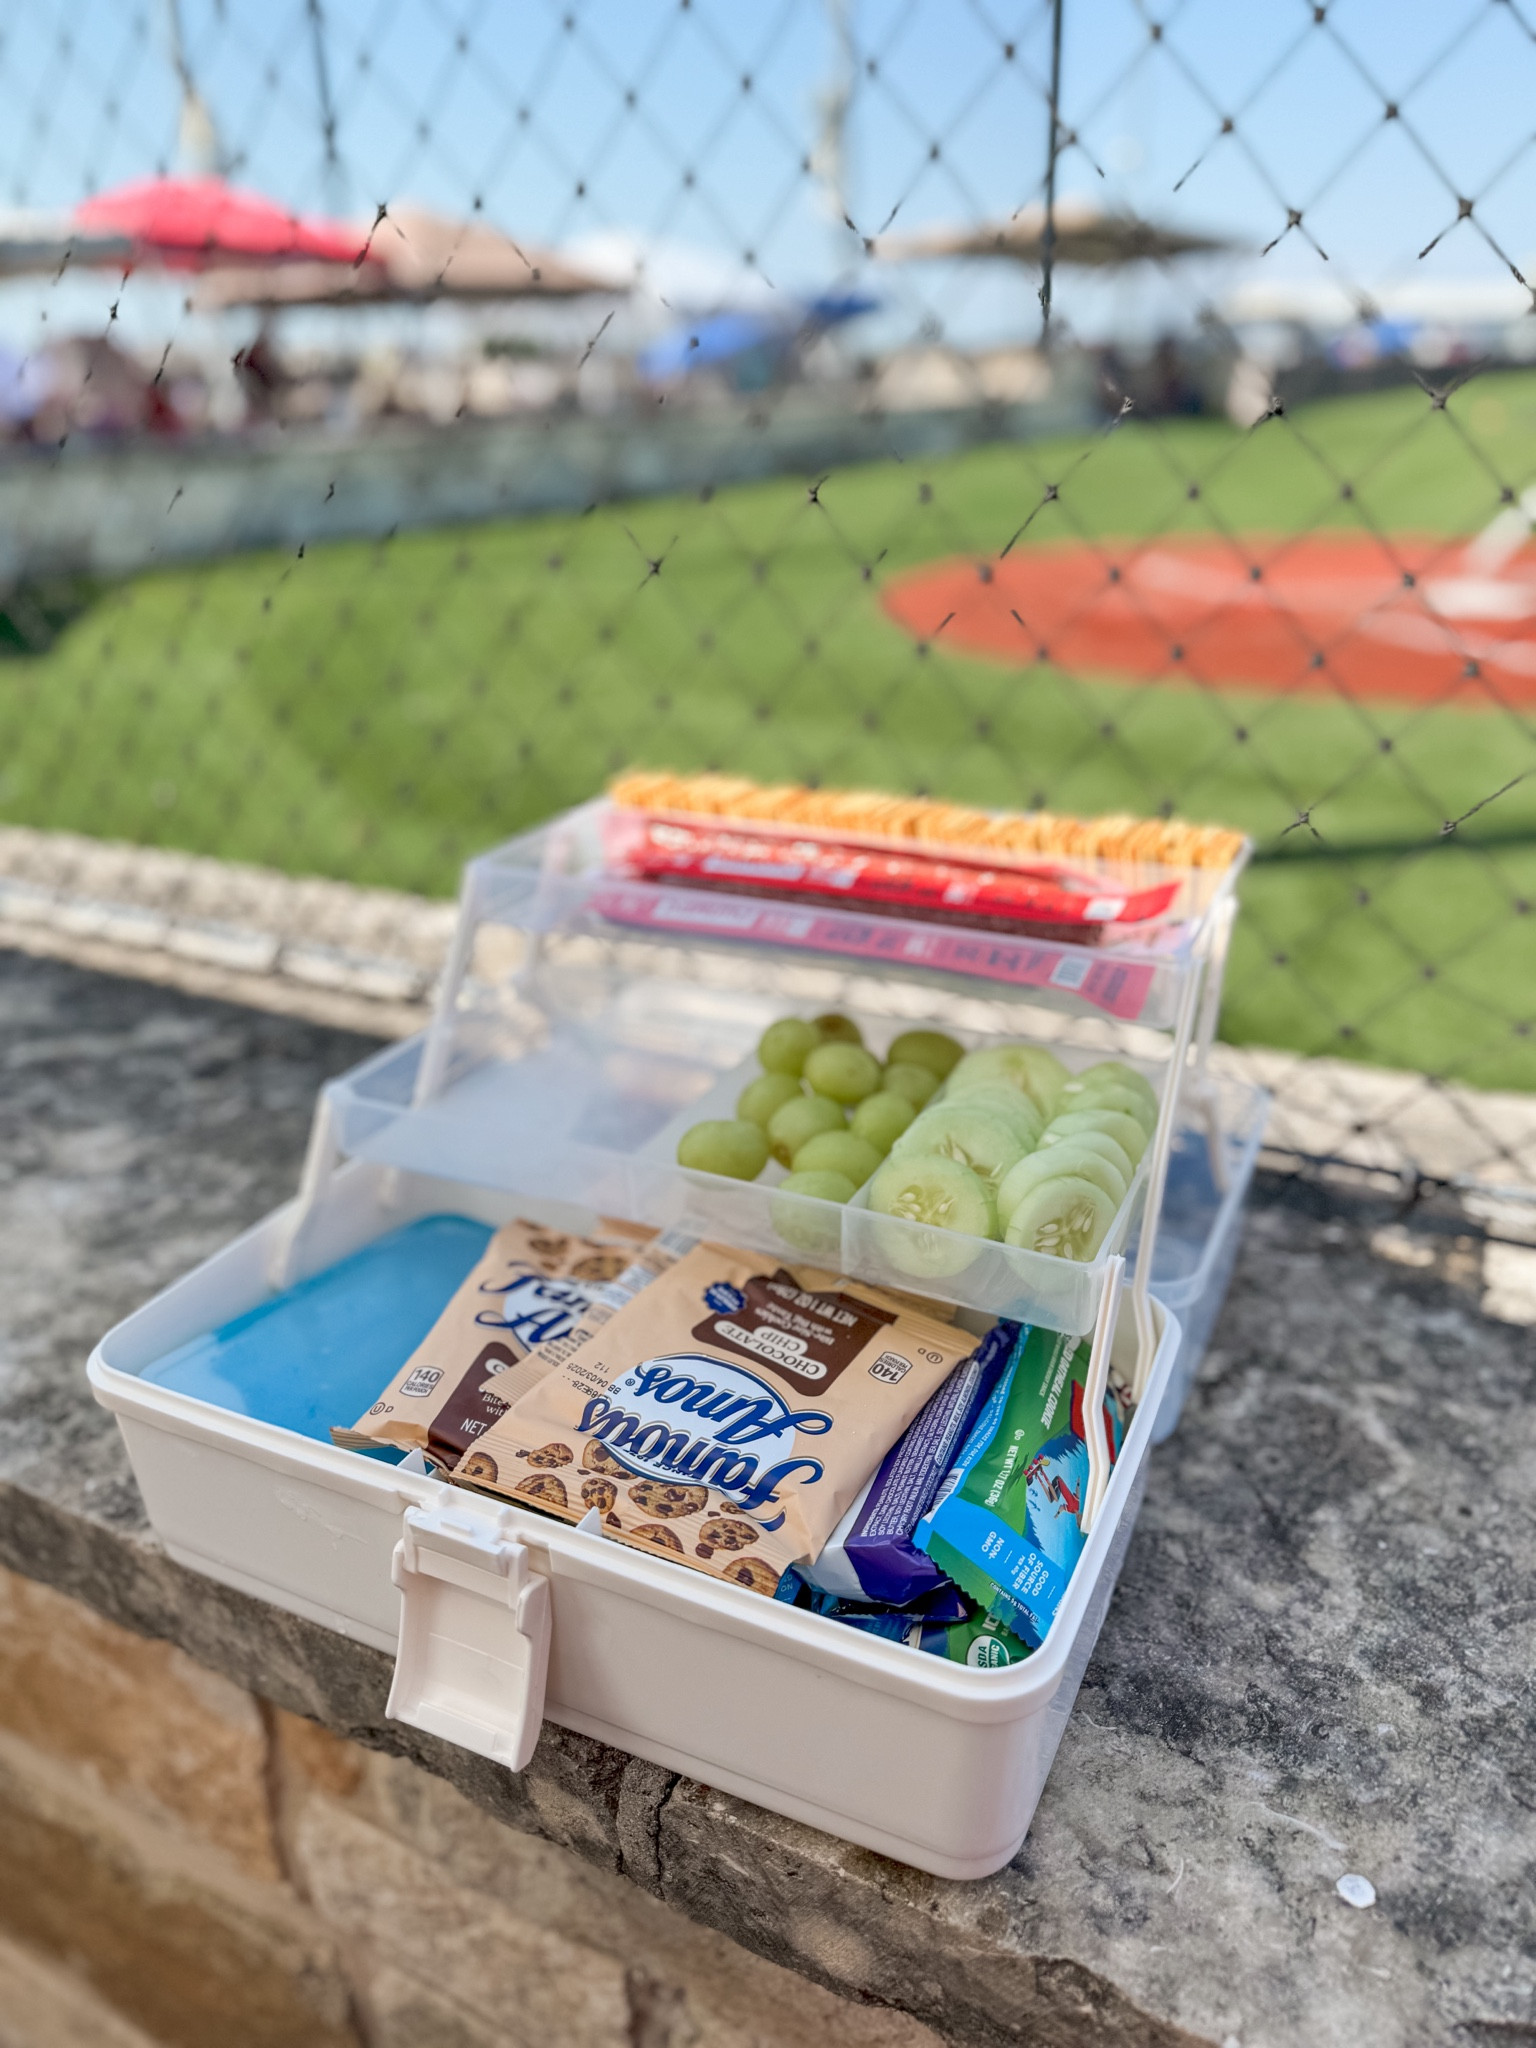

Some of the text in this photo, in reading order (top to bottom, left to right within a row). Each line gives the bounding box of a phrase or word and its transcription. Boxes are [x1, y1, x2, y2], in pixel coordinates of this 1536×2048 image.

[721, 1324, 820, 1376] CHOCOLATE
[760, 1331, 801, 1352] CHIP
[414, 1367, 440, 1383] 140
[565, 1361, 621, 1395] BB 04/03/2025
[593, 1360, 610, 1373] 112
[870, 1361, 899, 1382] 140
[1050, 1356, 1069, 1397] OATMEAL
[634, 1364, 834, 1446] Amos
[1040, 1392, 1058, 1430] COOKIE
[460, 1418, 488, 1436] NET
[1006, 1444, 1019, 1458] NET
[574, 1398, 825, 1532] Famous
[1003, 1457, 1015, 1470] WT
[992, 1478, 1004, 1490] OZ
[981, 1531, 996, 1552] GMO
[988, 1537, 1004, 1559] NON-
[1012, 1552, 1036, 1589] OF FIBER
[1020, 1560, 1043, 1593] SOURCE
[1031, 1569, 1049, 1596] GOOD
[989, 1582, 1011, 1600] CONTAINS
[1016, 1602, 1029, 1615] TOTAL
